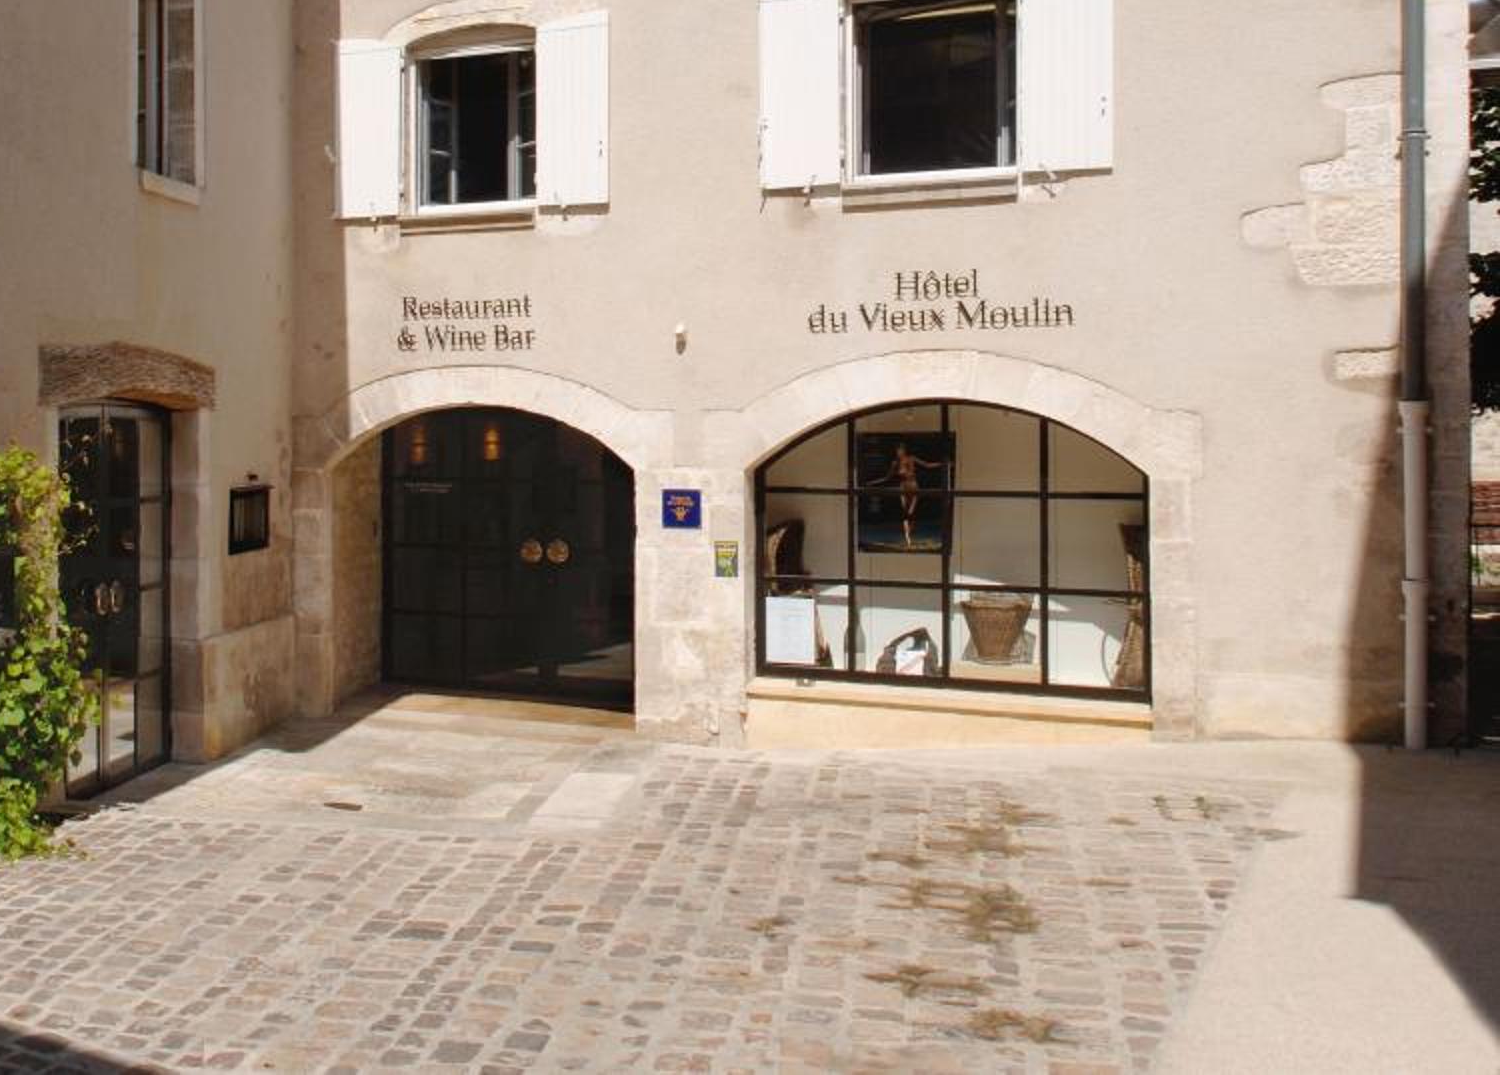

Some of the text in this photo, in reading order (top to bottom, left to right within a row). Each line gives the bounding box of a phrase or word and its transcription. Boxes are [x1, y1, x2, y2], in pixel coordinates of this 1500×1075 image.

[894, 269, 979, 301] Hôtel
[402, 295, 533, 321] Restaurant
[808, 297, 1075, 333] du Vieux Moulin
[397, 325, 536, 352] & Wine Bar
